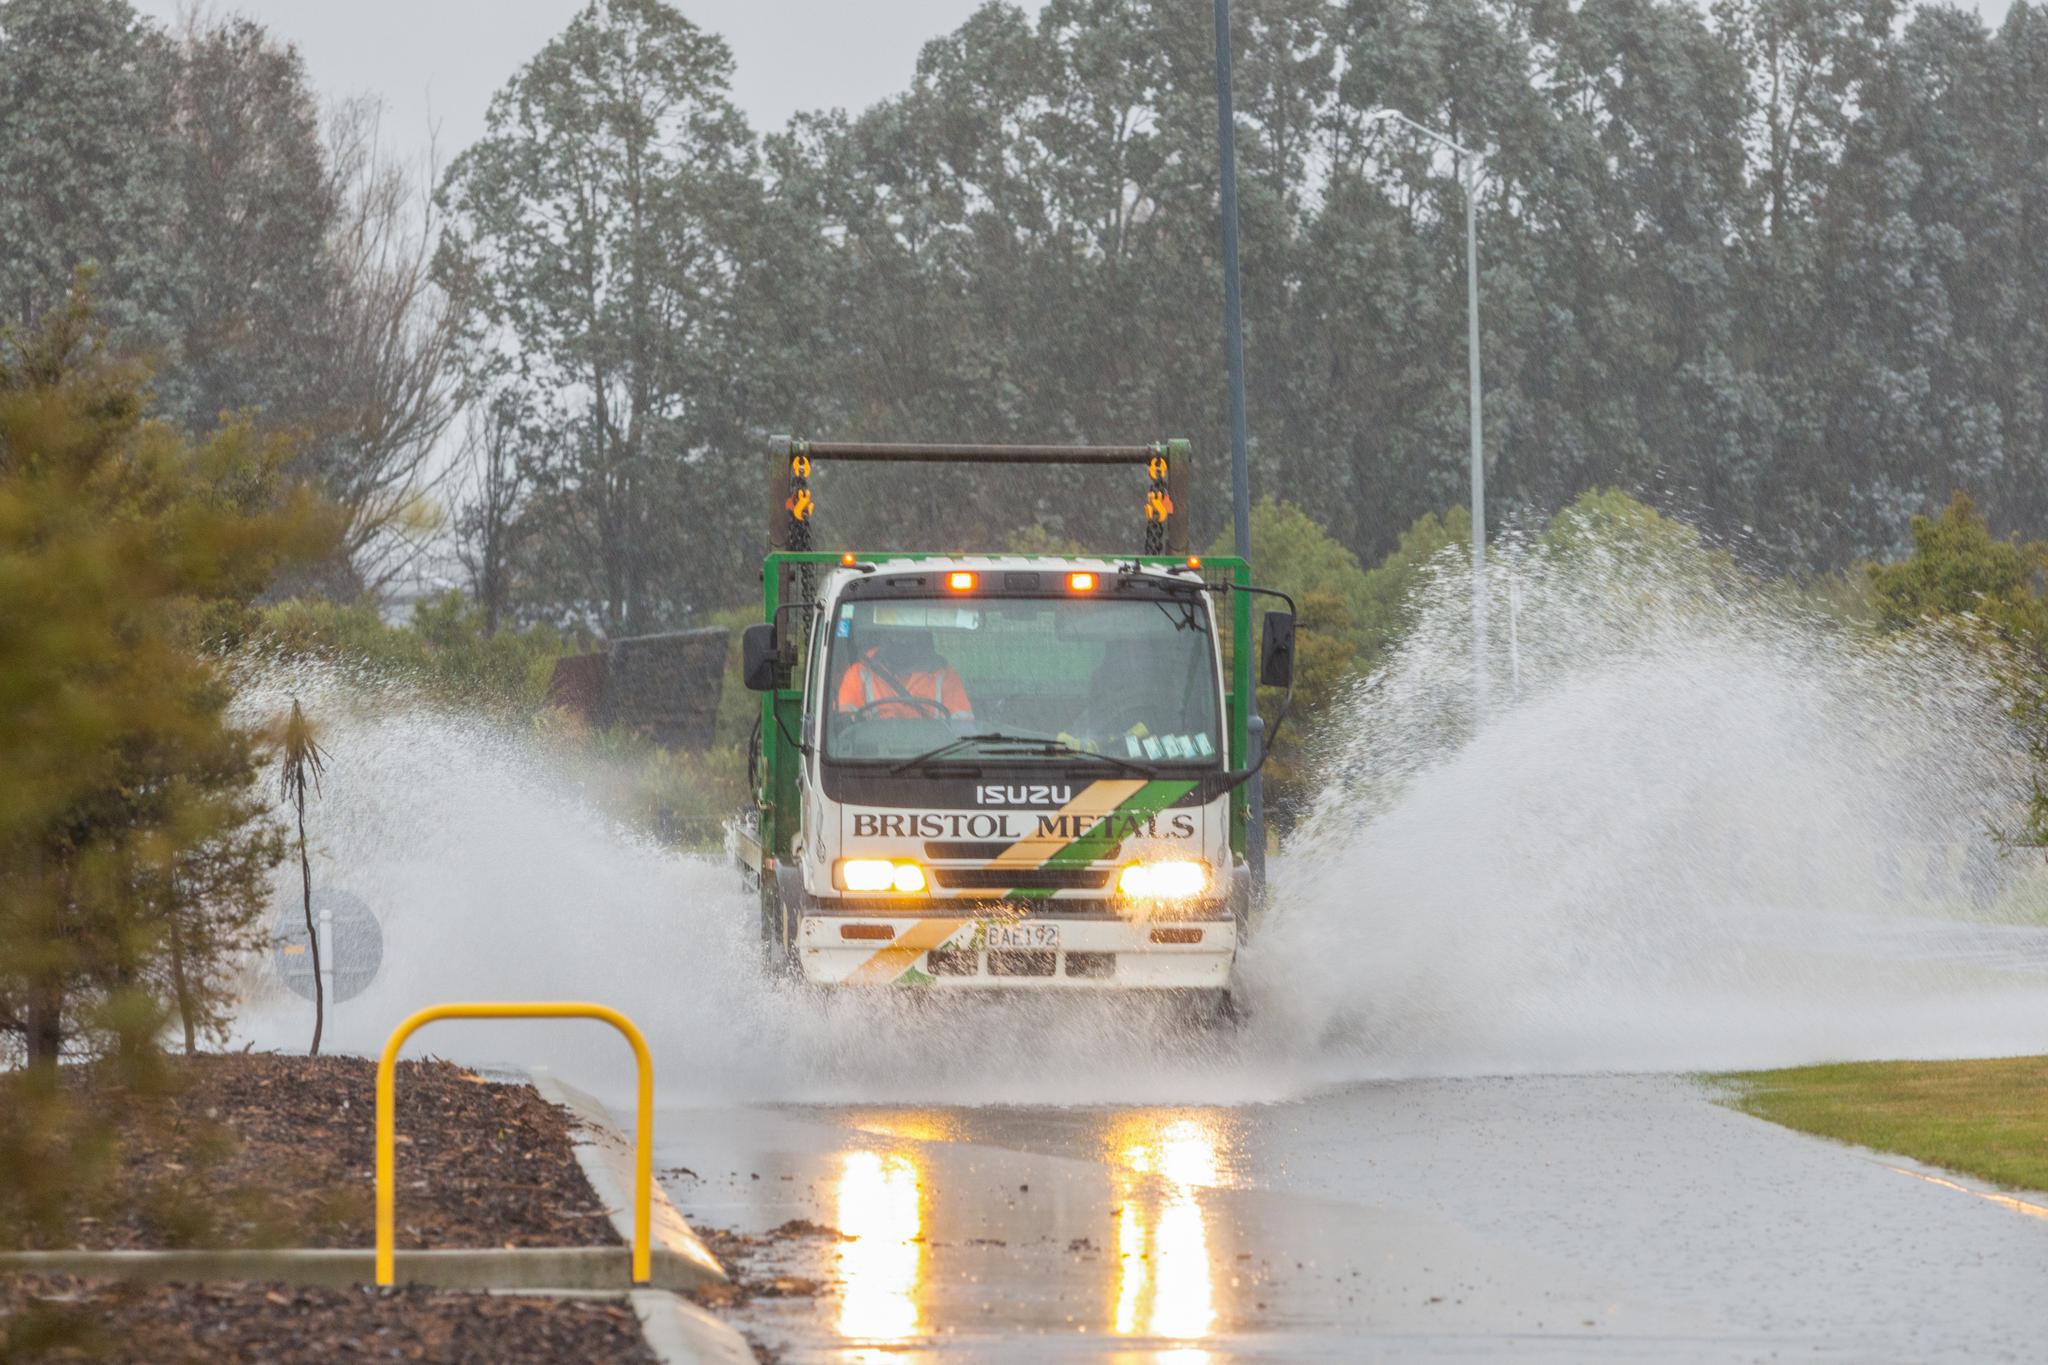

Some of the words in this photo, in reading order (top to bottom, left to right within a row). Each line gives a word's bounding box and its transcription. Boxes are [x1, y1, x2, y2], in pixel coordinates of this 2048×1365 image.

[977, 785, 1071, 804] ISUZU
[854, 814, 1020, 838] BRISTOL
[1036, 814, 1195, 839] METALS
